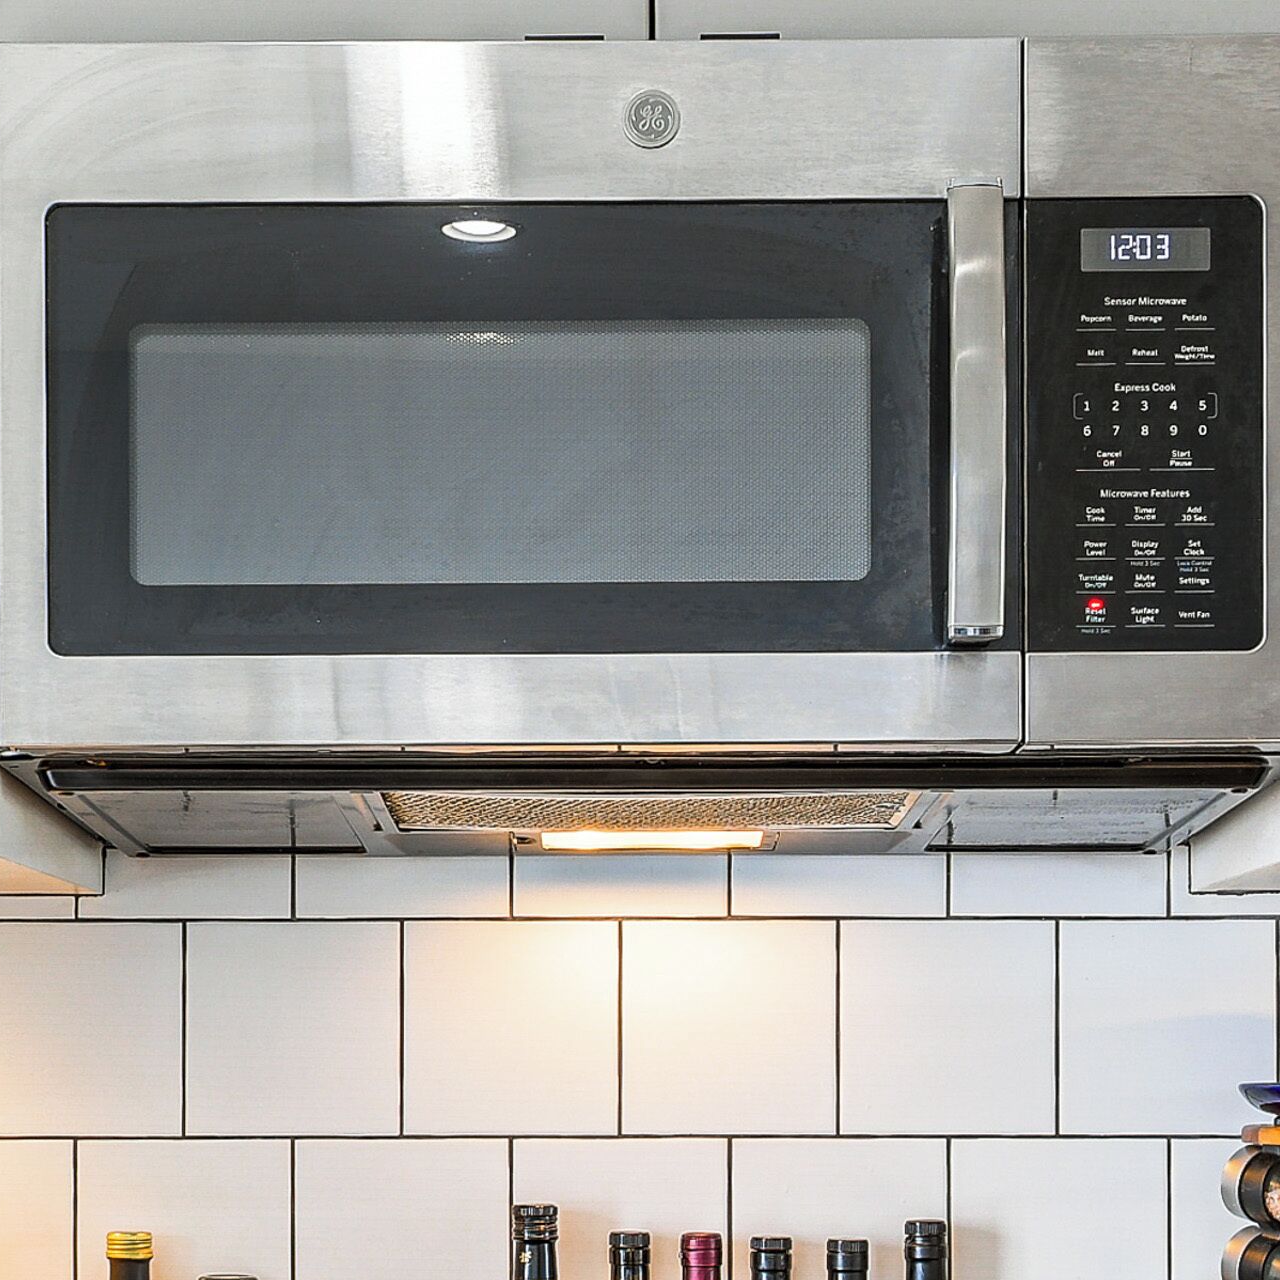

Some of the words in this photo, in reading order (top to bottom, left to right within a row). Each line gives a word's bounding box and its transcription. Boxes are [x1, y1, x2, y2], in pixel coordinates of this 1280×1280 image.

[1110, 234, 1170, 260] 12:03
[1104, 297, 1136, 306] Sensor
[1138, 297, 1187, 306] Microwave
[1080, 315, 1112, 324] Popcorn
[1128, 315, 1163, 324] Beverage
[1182, 314, 1207, 322] Potato
[1181, 345, 1209, 353] Defrost
[1114, 384, 1150, 393] Express
[1152, 383, 1176, 392] Cook
[1083, 401, 1091, 412] 1
[1111, 401, 1120, 412] 2
[1140, 401, 1149, 412] 3
[1169, 401, 1178, 412] 4
[1198, 401, 1207, 412] 5
[1083, 425, 1092, 436] 6
[1112, 425, 1120, 436] 7
[1140, 425, 1149, 436] 8
[1169, 425, 1178, 436] 9
[1198, 425, 1207, 436] 0
[1096, 450, 1122, 458] Cancel
[1171, 450, 1191, 458] Start
[1100, 489, 1149, 498] Microwave
[1150, 489, 1190, 498] Features
[1086, 506, 1105, 514] Cook
[1134, 506, 1156, 514] Timer
[1186, 506, 1202, 514] Add
[1181, 514, 1192, 522] 30
[1193, 514, 1207, 522] Sec
[1131, 540, 1159, 549] Display
[1188, 540, 1201, 548] Set
[1183, 548, 1205, 556] Clock
[1078, 574, 1114, 582] Turntable
[1135, 574, 1155, 582] Mute
[1179, 577, 1210, 586] Settings
